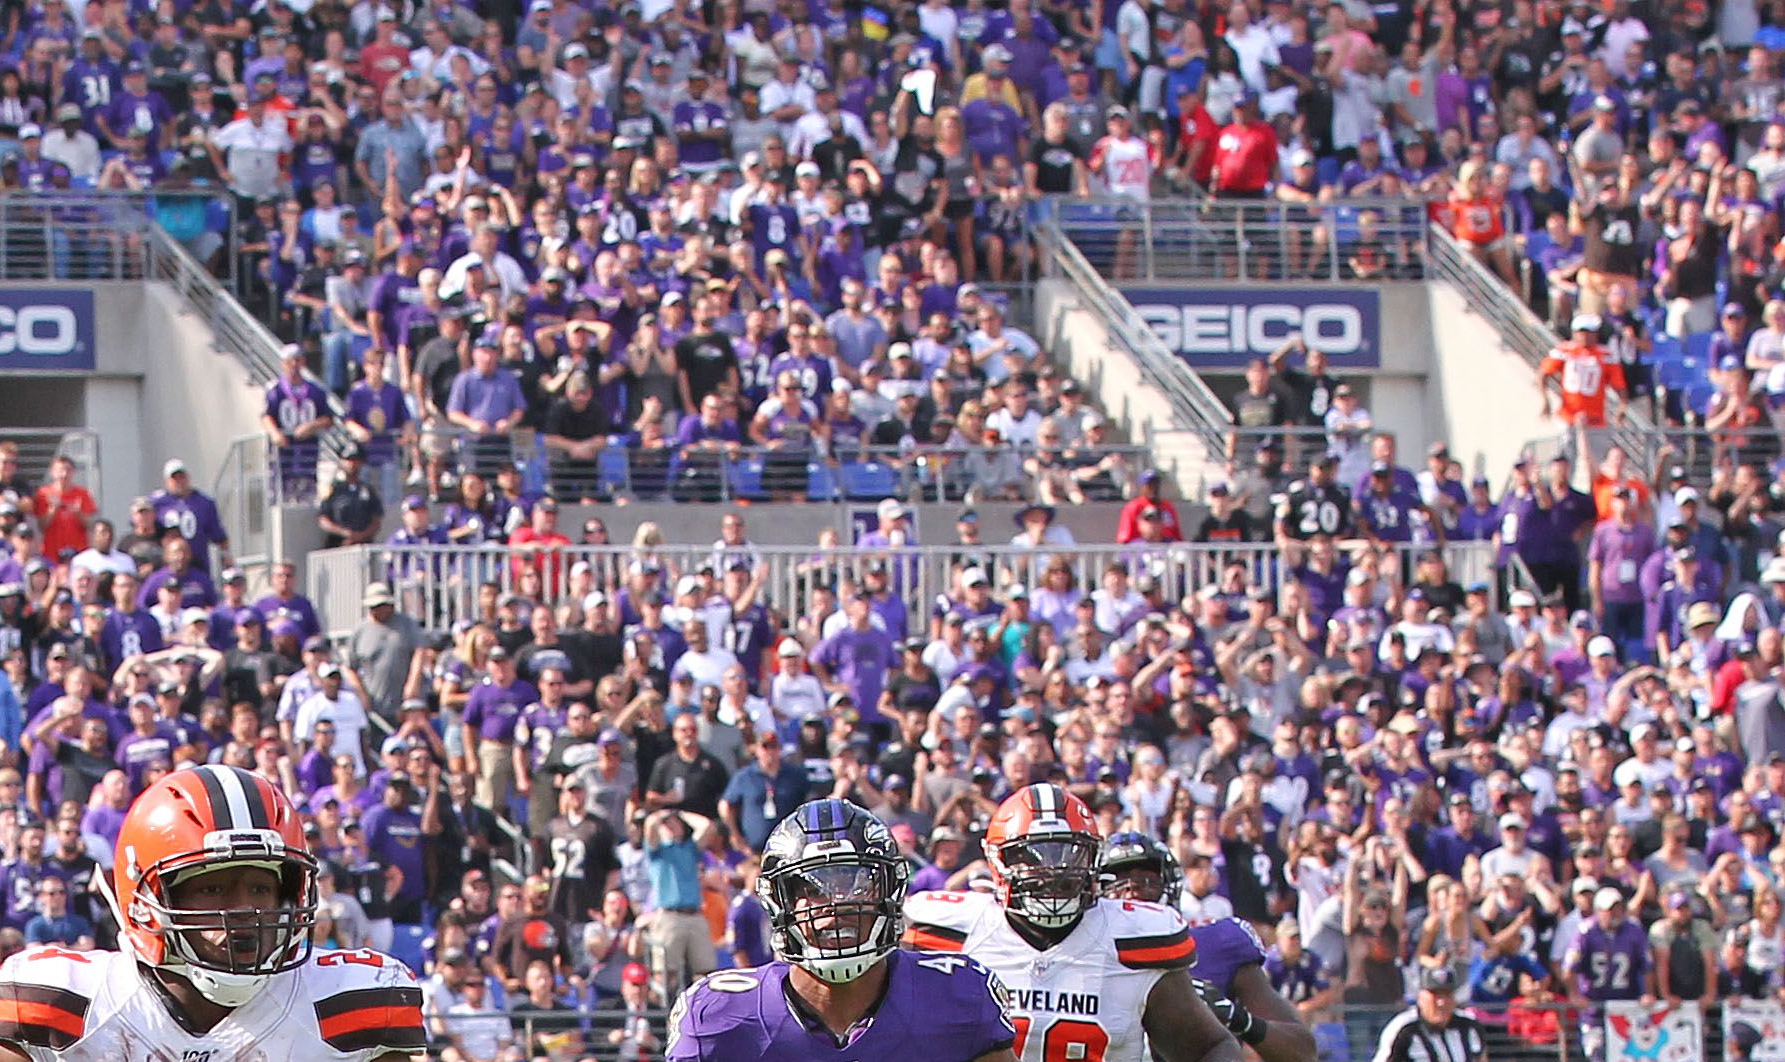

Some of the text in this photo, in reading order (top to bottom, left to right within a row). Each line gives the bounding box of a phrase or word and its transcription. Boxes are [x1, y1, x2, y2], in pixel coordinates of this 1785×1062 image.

[81, 76, 112, 107] 31
[1126, 304, 1362, 353] GEICO
[1299, 499, 1341, 535] 20
[551, 838, 587, 879] 52
[1590, 951, 1631, 989] 52
